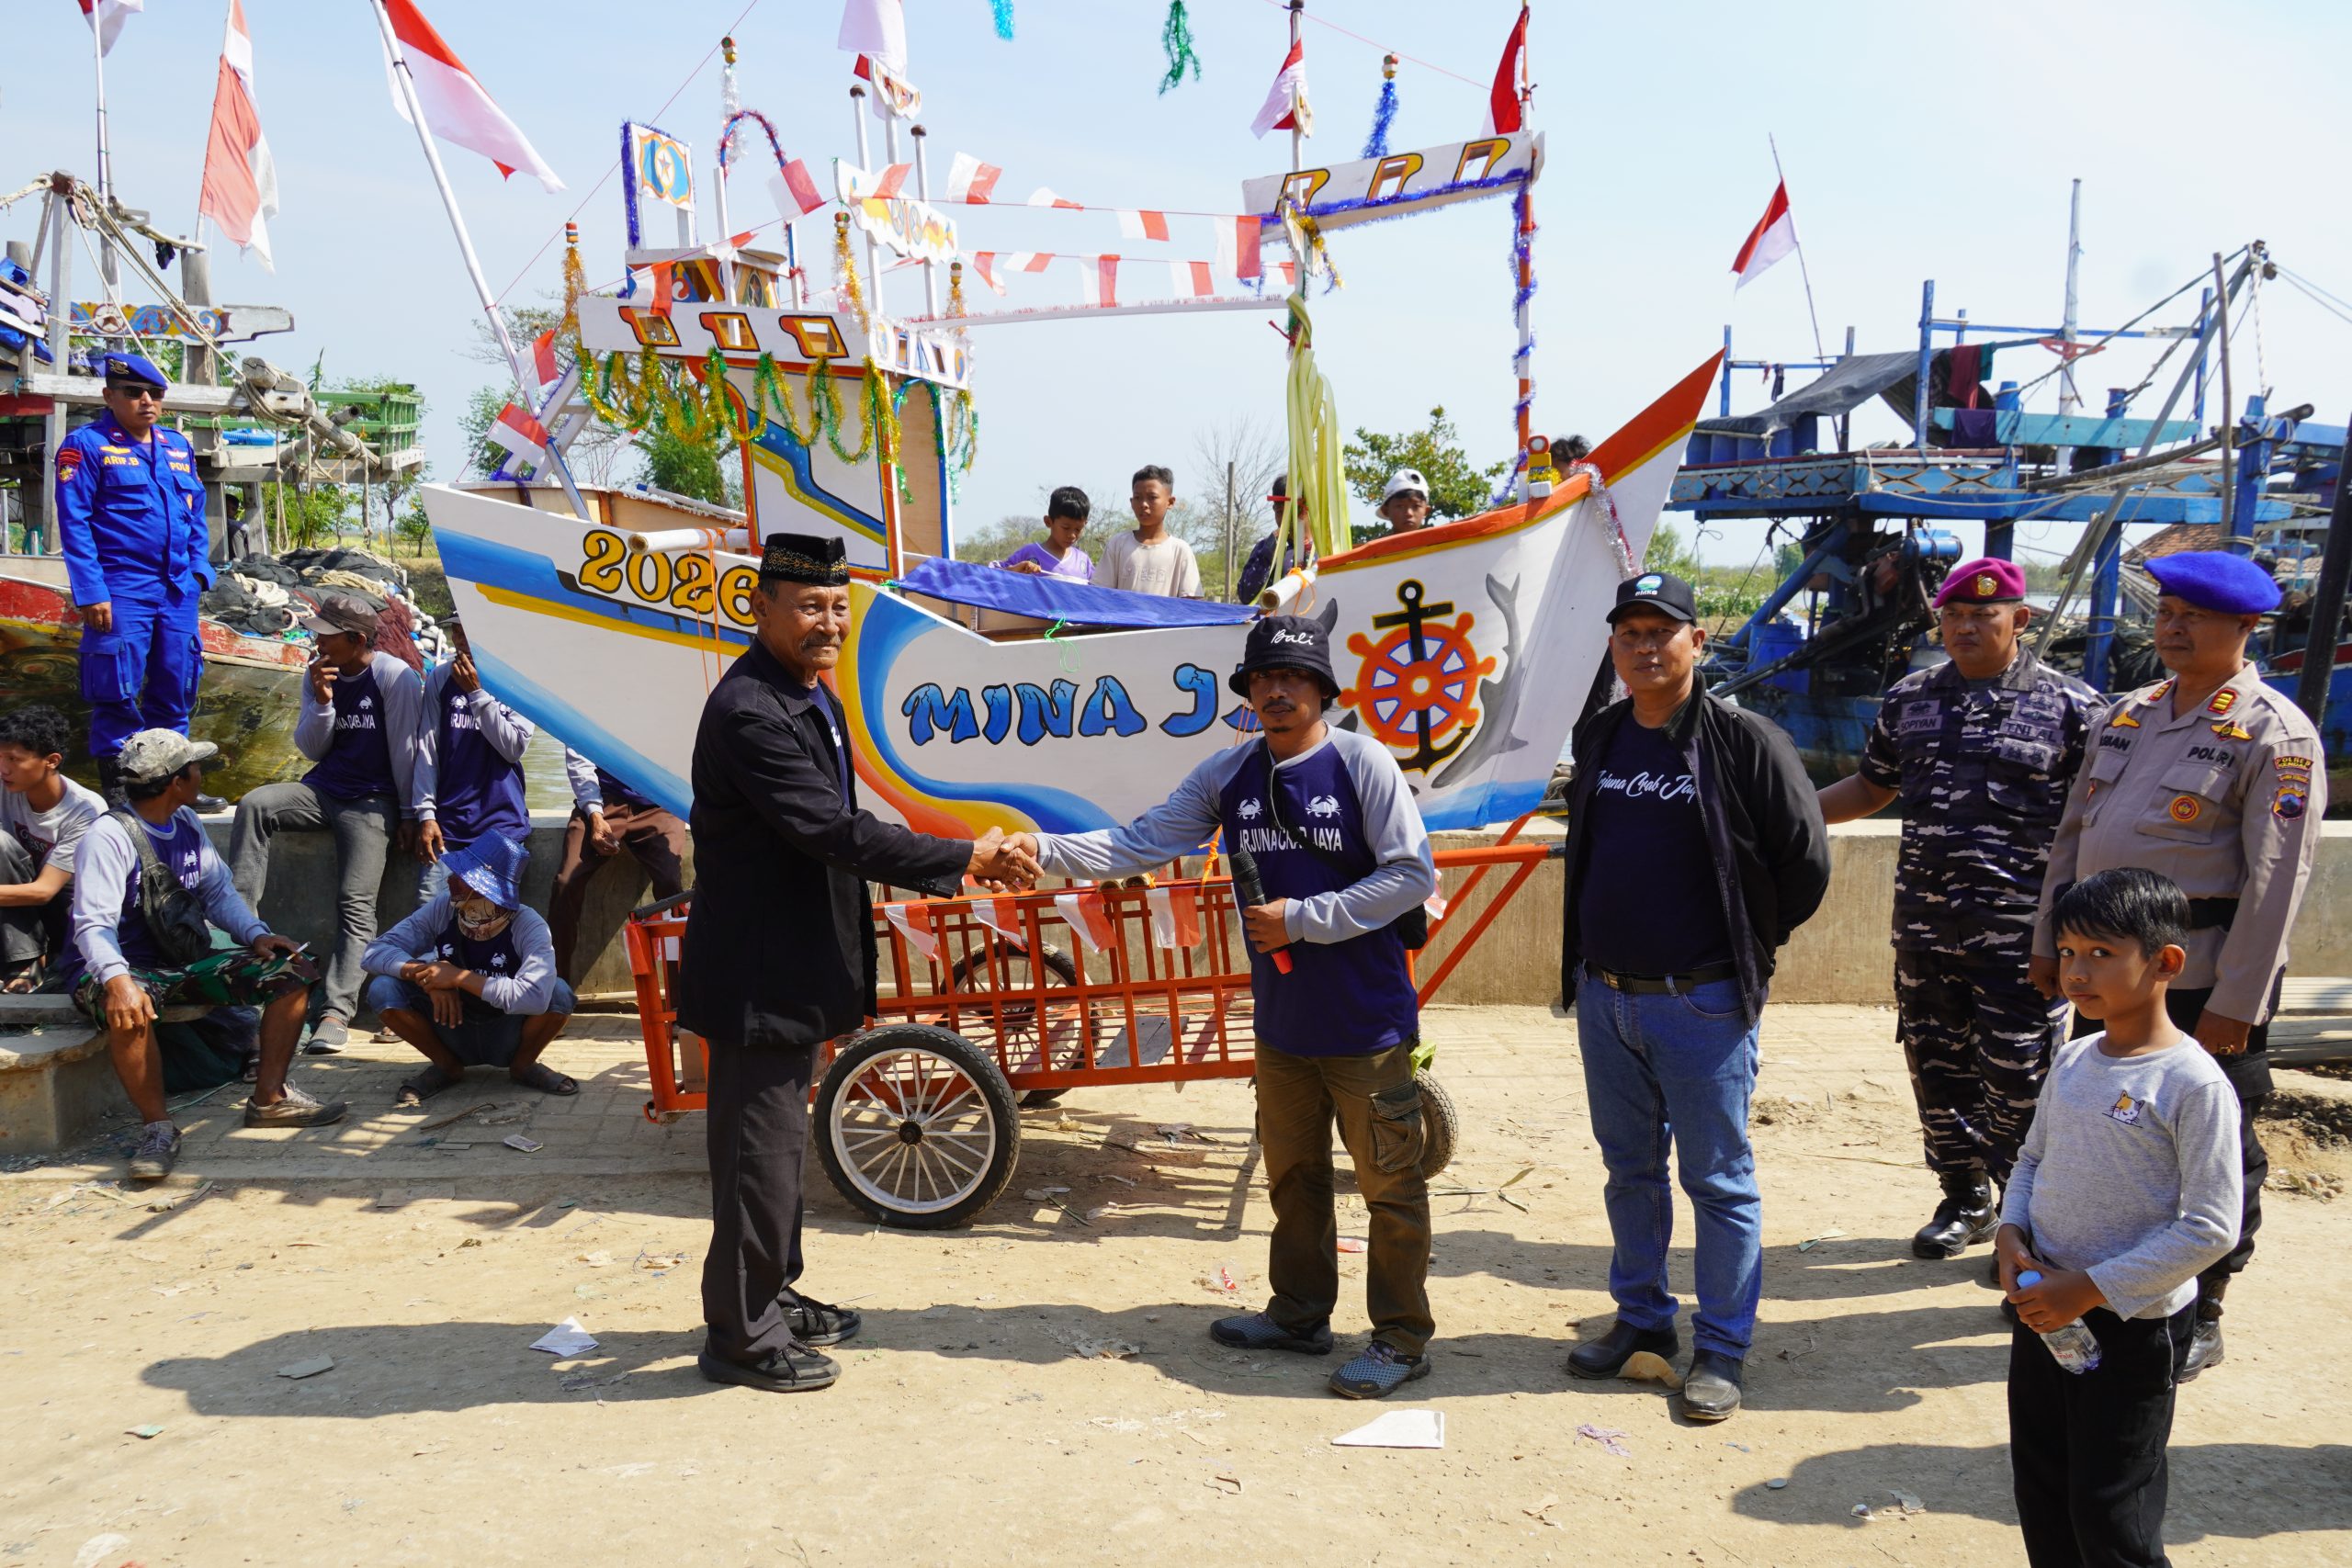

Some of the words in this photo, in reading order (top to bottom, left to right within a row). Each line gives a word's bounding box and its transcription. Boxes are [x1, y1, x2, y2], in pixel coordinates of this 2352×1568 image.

[578, 529, 760, 626] 2026
[1271, 628, 1314, 646] Bali
[901, 674, 1148, 746] MINA
[1901, 717, 1937, 732] SOPIYAN
[2007, 722, 2031, 736] TNI
[2036, 728, 2055, 741] AL
[2188, 746, 2235, 768] POLRI
[1626, 772, 1665, 797] Crab
[1659, 774, 1697, 804] Jay
[1239, 828, 1277, 852] ARJUNA
